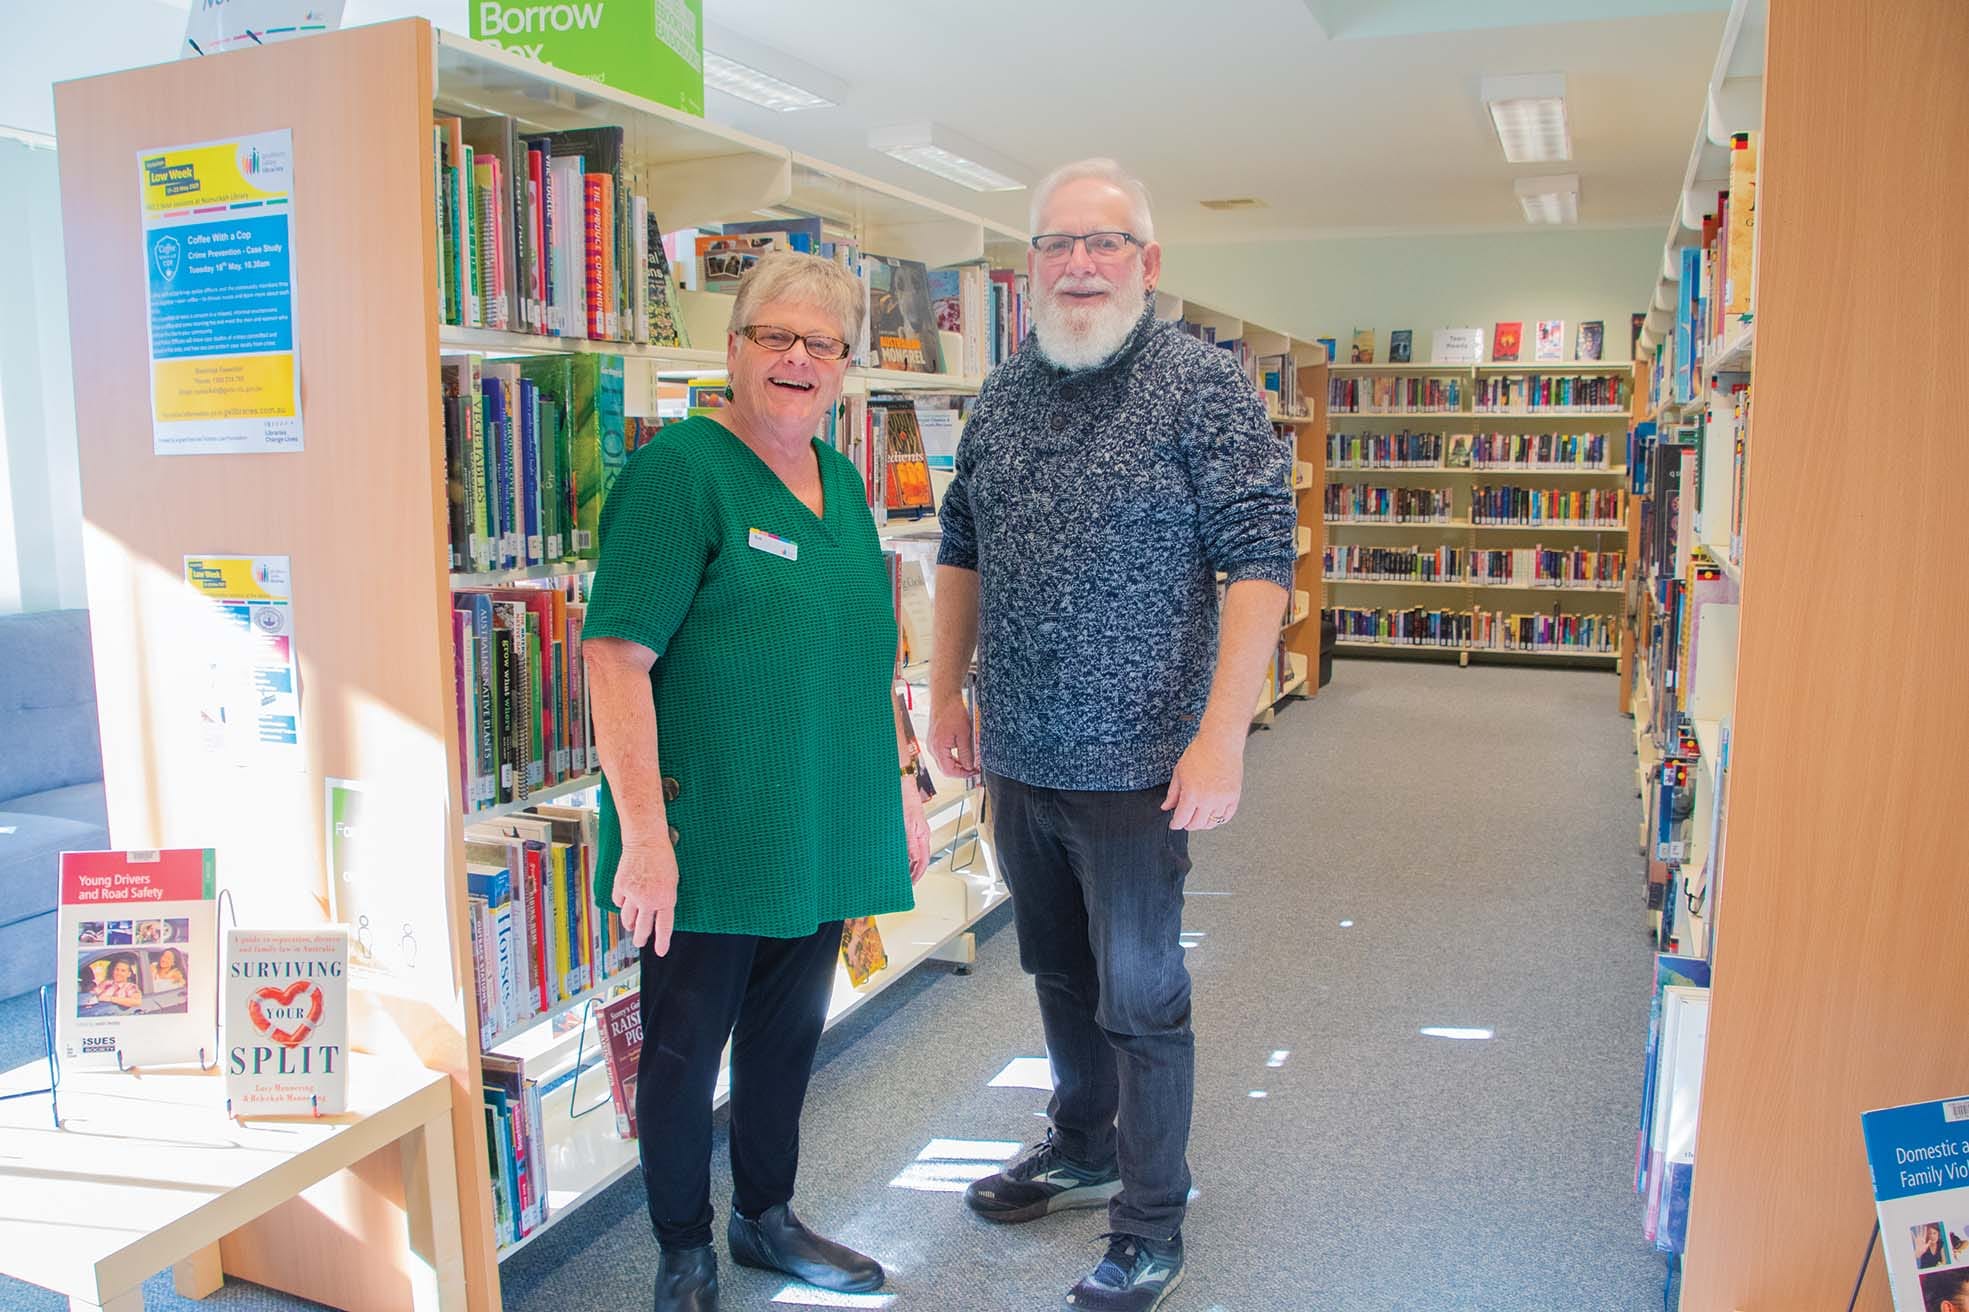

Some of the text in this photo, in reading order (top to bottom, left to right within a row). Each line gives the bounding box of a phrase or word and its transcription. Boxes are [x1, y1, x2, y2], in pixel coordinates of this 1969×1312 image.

[480, 1, 604, 36] Borrow
[169, 167, 193, 181] Week
[187, 235, 211, 245] Coffee
[212, 233, 229, 242] With
[236, 230, 251, 240] Cop
[593, 207, 602, 252] PRODUCE
[208, 248, 241, 258] Prevention
[246, 246, 262, 254] Case
[263, 244, 282, 253] Study
[189, 265, 214, 274] Tuesday
[473, 400, 485, 503] VEGETABLES
[480, 608, 492, 759] AUSTRALIAN NATIVE PLANTS
[502, 639, 512, 732] grow what where
[78, 873, 151, 888] Young Drivers
[78, 886, 163, 900] and Road Safety
[231, 961, 342, 978] SURVIVING
[479, 964, 487, 1005] STATIONS
[266, 1007, 304, 1019] YOUR
[230, 1045, 339, 1075] SPLIT
[1896, 1139, 1959, 1165] Domestic
[1900, 1165, 1943, 1188] Family
